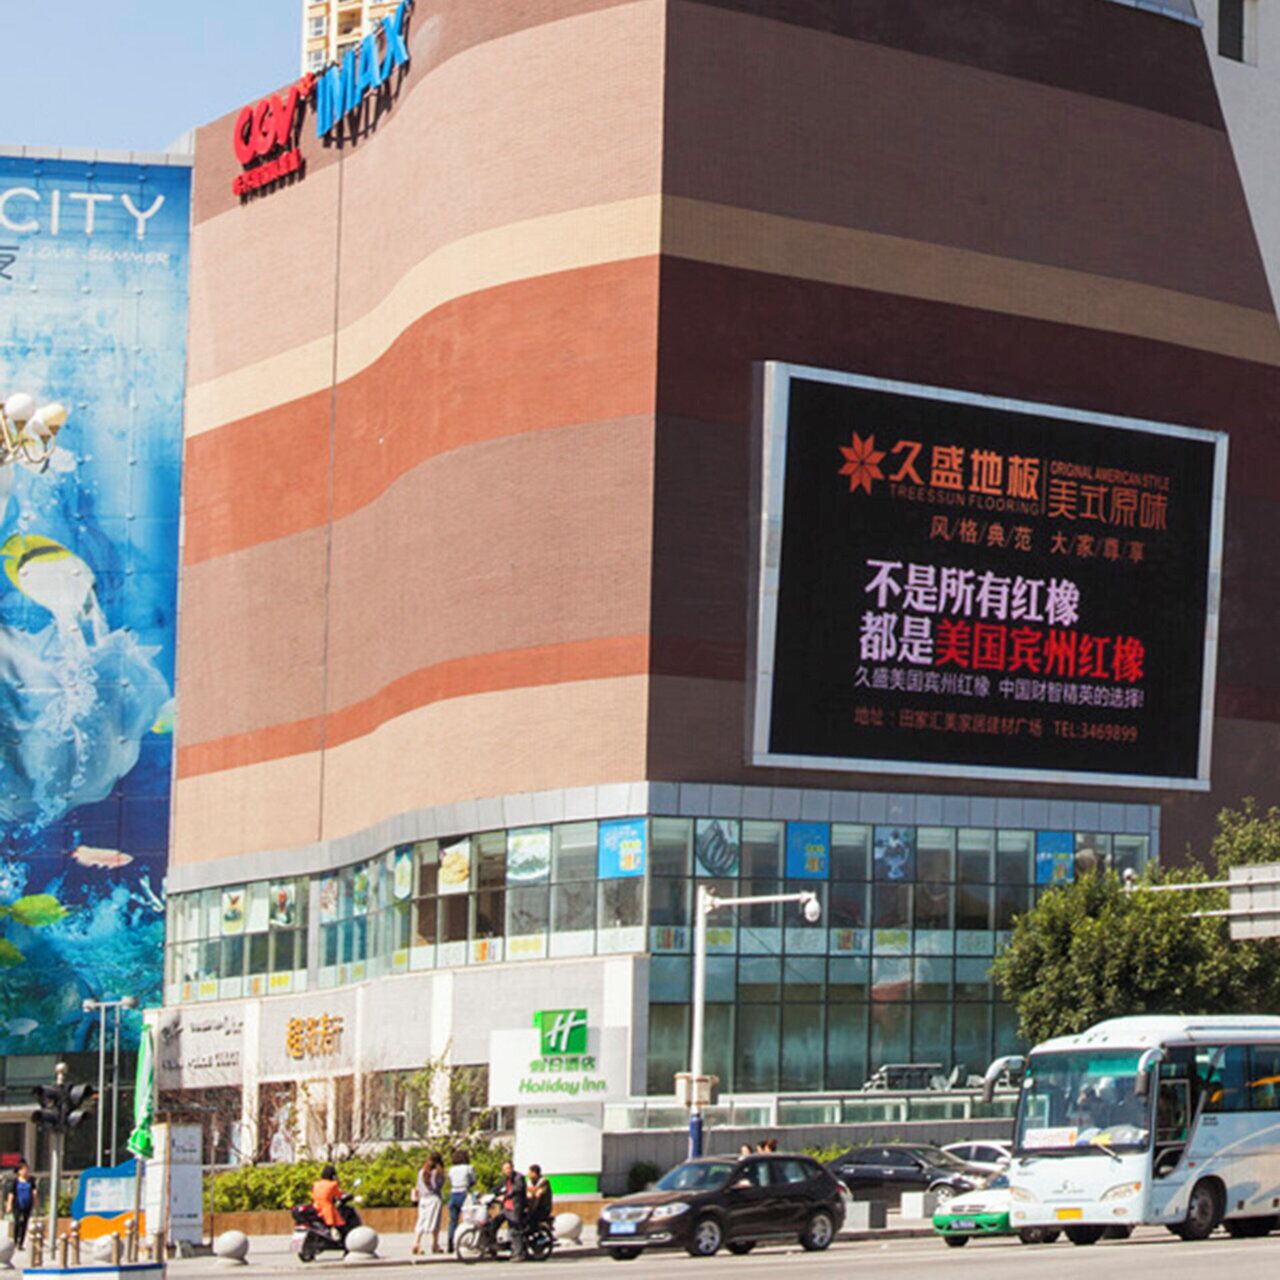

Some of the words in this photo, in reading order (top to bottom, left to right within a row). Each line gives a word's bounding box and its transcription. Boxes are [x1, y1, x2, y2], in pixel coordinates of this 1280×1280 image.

[233, 86, 300, 166] CGV
[0, 186, 166, 241] CITY
[888, 439, 1041, 502] 久盛地板
[888, 483, 965, 508] TREESSUN
[967, 494, 1041, 516] FLOORING
[1046, 477, 1170, 530] 美式原味
[864, 558, 1081, 627] 不是所有红橡
[858, 611, 1146, 684] 都是美国宾州红橡
[518, 1077, 580, 1096] Holiday
[581, 1076, 607, 1092] Inn
